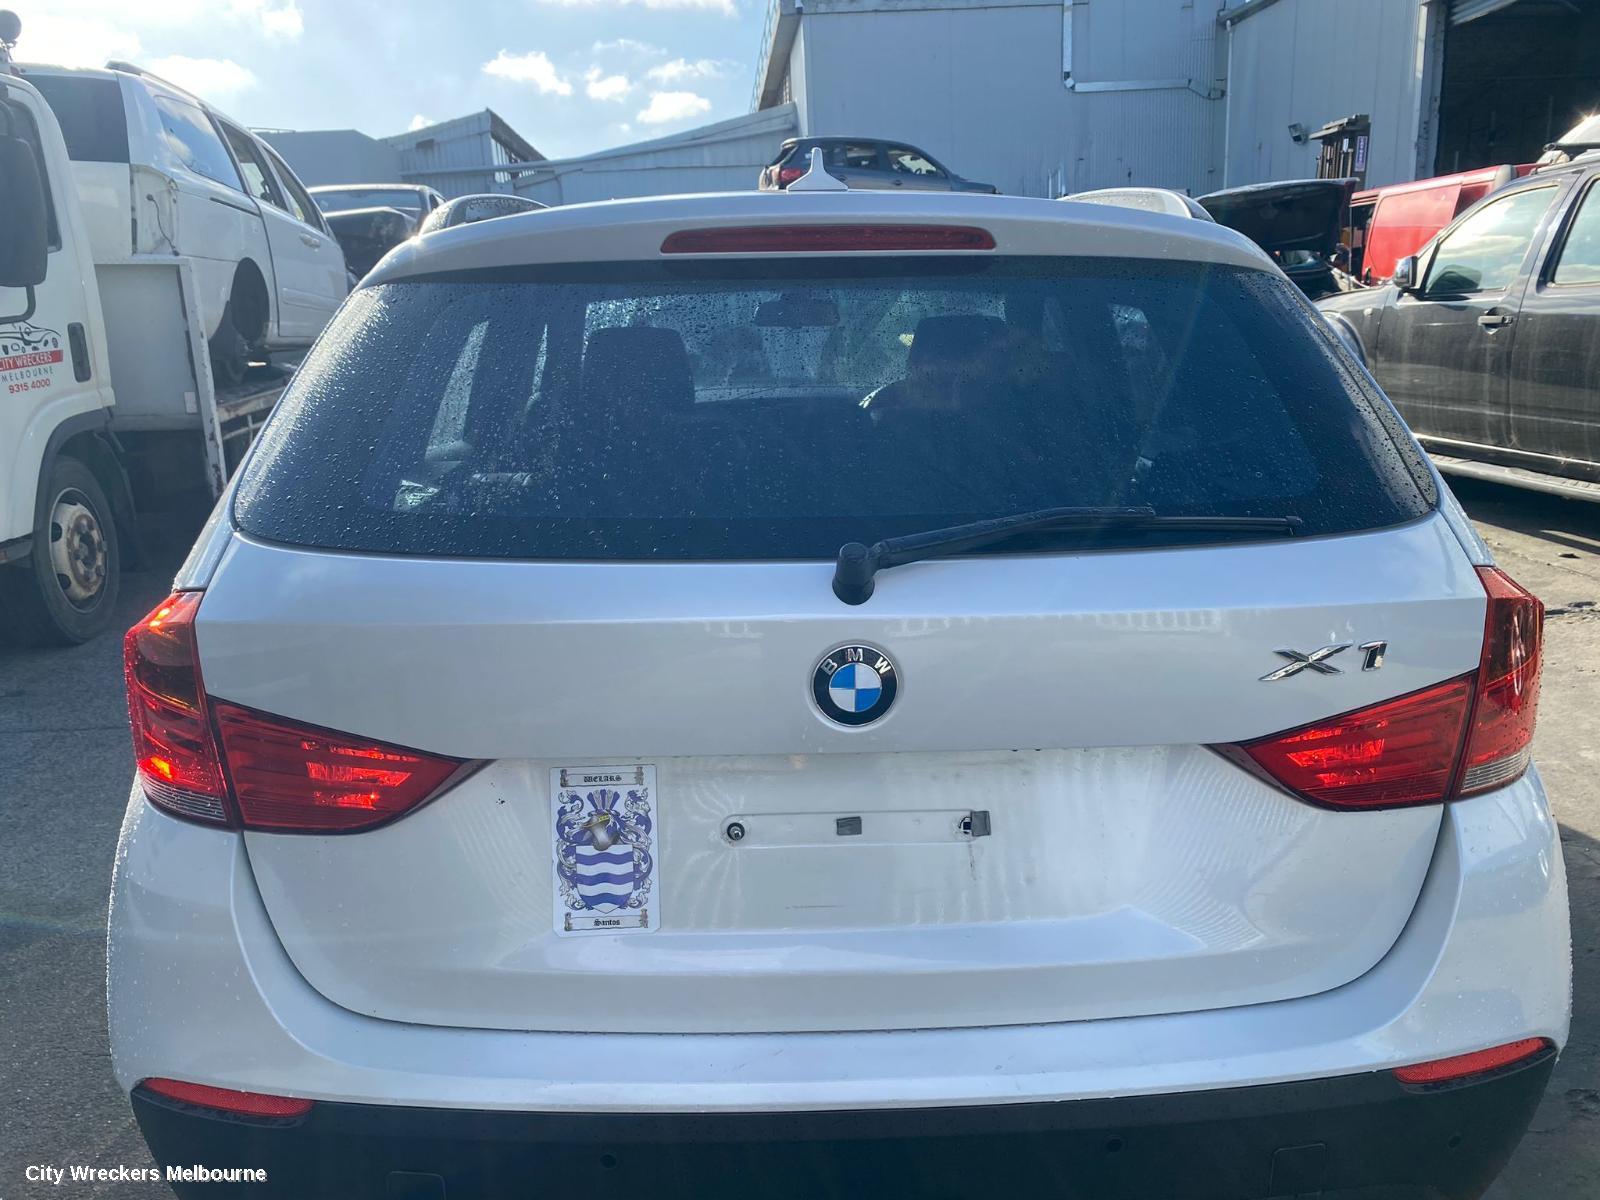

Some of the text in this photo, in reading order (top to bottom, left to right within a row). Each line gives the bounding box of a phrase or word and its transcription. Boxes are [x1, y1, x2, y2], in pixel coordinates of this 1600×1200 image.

[15, 351, 53, 368] WRECKERS
[1, 366, 54, 382] MELBOURNE
[9, 378, 51, 394] 9315 4000
[820, 647, 892, 676] BMW
[1258, 640, 1387, 680] X1
[593, 918, 621, 926] Santos
